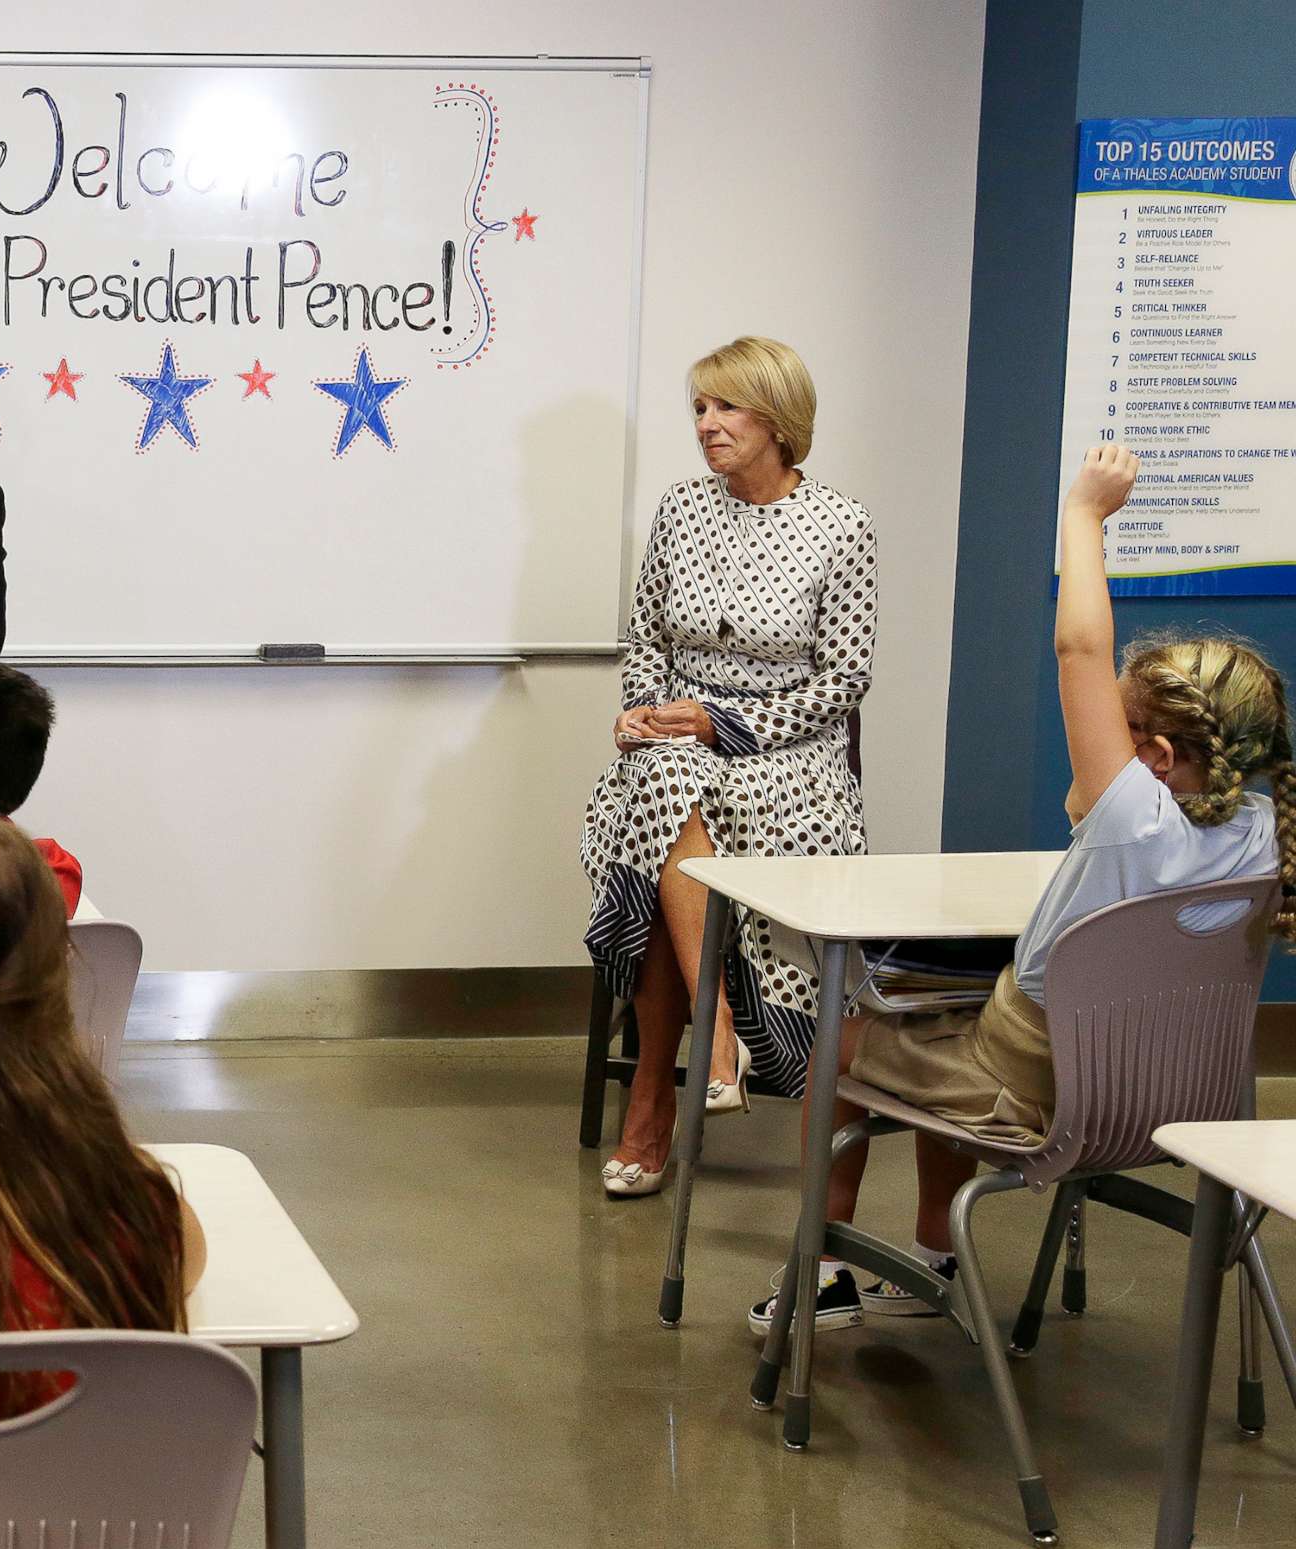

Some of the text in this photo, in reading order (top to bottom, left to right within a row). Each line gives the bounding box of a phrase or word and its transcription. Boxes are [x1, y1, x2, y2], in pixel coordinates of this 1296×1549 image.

[1096, 140, 1275, 162] TOP 15 OUTCOMES
[1094, 166, 1283, 181] OF A THALES ACADEMY STUDENT
[1122, 208, 1128, 220] 1
[1138, 205, 1182, 215] UNFAILING
[1184, 205, 1227, 215] INTEGRITY
[1119, 229, 1213, 244] 2 VIRTUOUS LEADER
[1117, 257, 1125, 269] 3
[1135, 254, 1199, 263] SELF-RELIANCE
[4, 235, 261, 326] President
[278, 239, 456, 336] Pence!
[1115, 281, 1123, 293] 4
[1134, 279, 1160, 288] TRUTH
[1163, 279, 1194, 288] SEEKER
[1114, 304, 1207, 318] 5 CRITICAL THINKER
[1112, 328, 1223, 343] 6 CONTINUOUS LEARNER
[1112, 352, 1256, 367] 7 COMPETENT TECHNICAL SKILLS
[1109, 380, 1117, 393] 8
[1128, 377, 1158, 387] ASTUTE
[1161, 377, 1200, 387] PROBLEM
[1203, 377, 1237, 387] SOLVING
[1108, 404, 1115, 417] 9
[1125, 401, 1182, 411] COOPERATIVE
[1184, 401, 1190, 411] &
[1192, 401, 1251, 411] CONTRIBUTIVE
[1254, 401, 1277, 411] TEAM
[1099, 426, 1210, 441] 10 STRONG WORK ETHIC
[1160, 449, 1166, 459] &
[1169, 449, 1222, 459] ASPIRATIONS
[1225, 449, 1235, 459] TO
[1237, 449, 1271, 459] CHANGE
[1274, 449, 1289, 459] THE
[1178, 474, 1220, 484] AMERICAN
[1223, 474, 1254, 484] VALUES
[1126, 497, 1220, 507] OMMUNICATION SKILLS
[1118, 522, 1164, 531] GRATITUDE
[1117, 545, 1152, 555] HEALTHY
[1155, 545, 1179, 555] MIND,
[1181, 545, 1202, 555] BODY
[1204, 545, 1211, 555] &
[1213, 545, 1240, 555] SPIRIT
